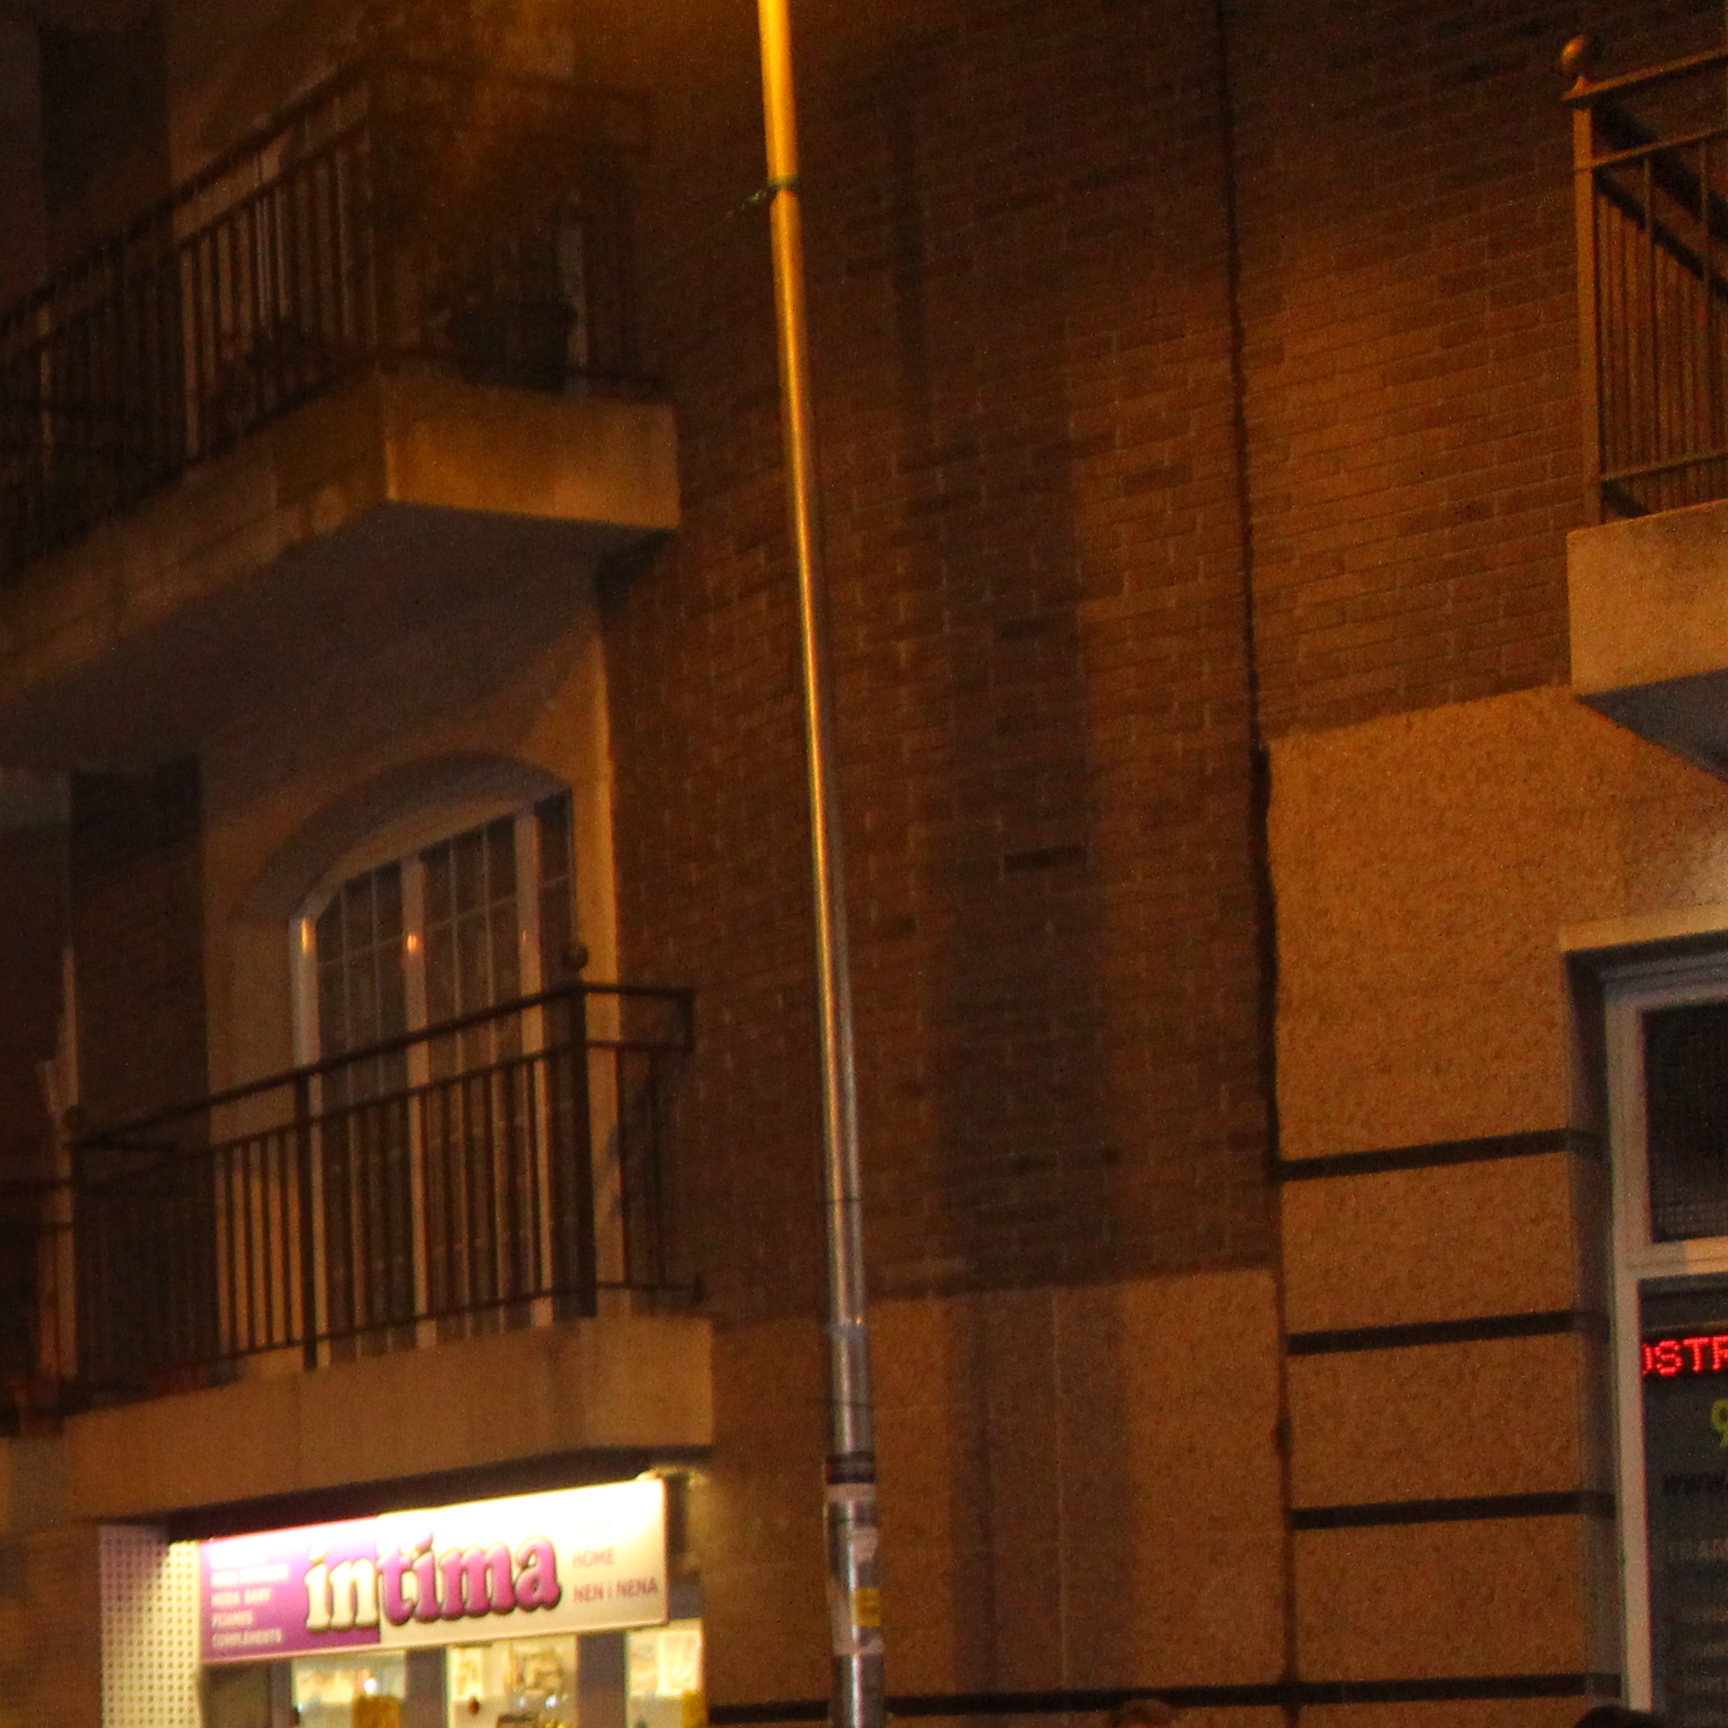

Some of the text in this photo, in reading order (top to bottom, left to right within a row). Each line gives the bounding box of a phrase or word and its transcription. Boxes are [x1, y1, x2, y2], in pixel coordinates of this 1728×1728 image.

[572, 1546, 615, 1568] HOME
[573, 1583, 605, 1604] NEN
[616, 1577, 659, 1599] NENA
